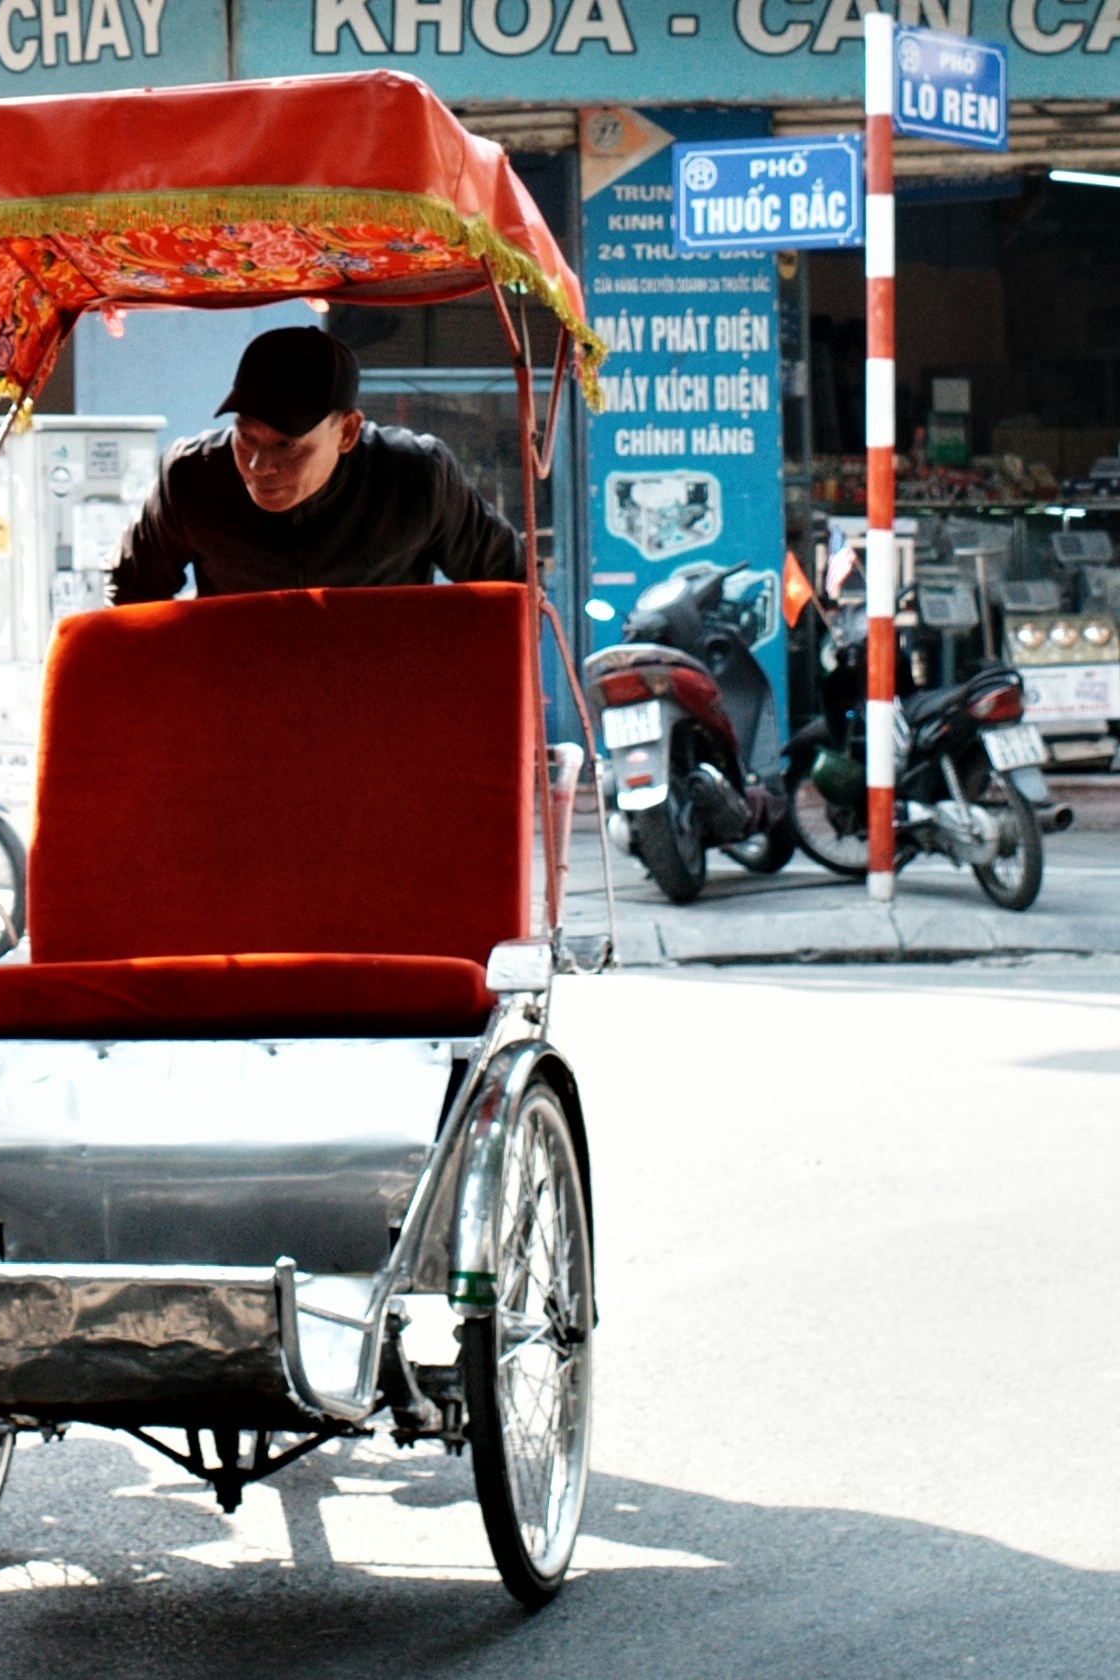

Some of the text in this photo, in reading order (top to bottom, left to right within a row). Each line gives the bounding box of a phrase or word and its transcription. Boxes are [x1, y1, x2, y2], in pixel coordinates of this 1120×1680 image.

[669, 16, 698, 36] -
[939, 47, 977, 75] PHỐ
[902, 71, 999, 133] LÒ RÈN
[749, 150, 808, 179] PHỐ
[613, 185, 673, 201] TRUN
[690, 177, 847, 235] THUỐC BẮC
[608, 214, 665, 230] KINH
[598, 244, 626, 260] 24
[631, 244, 712, 260] THU
[595, 308, 769, 360] MÁY PHÁT ĐIỆN
[598, 367, 769, 420] MÁY KÍCH ĐIỆN
[615, 423, 755, 456] CHÍNH HÃNG
